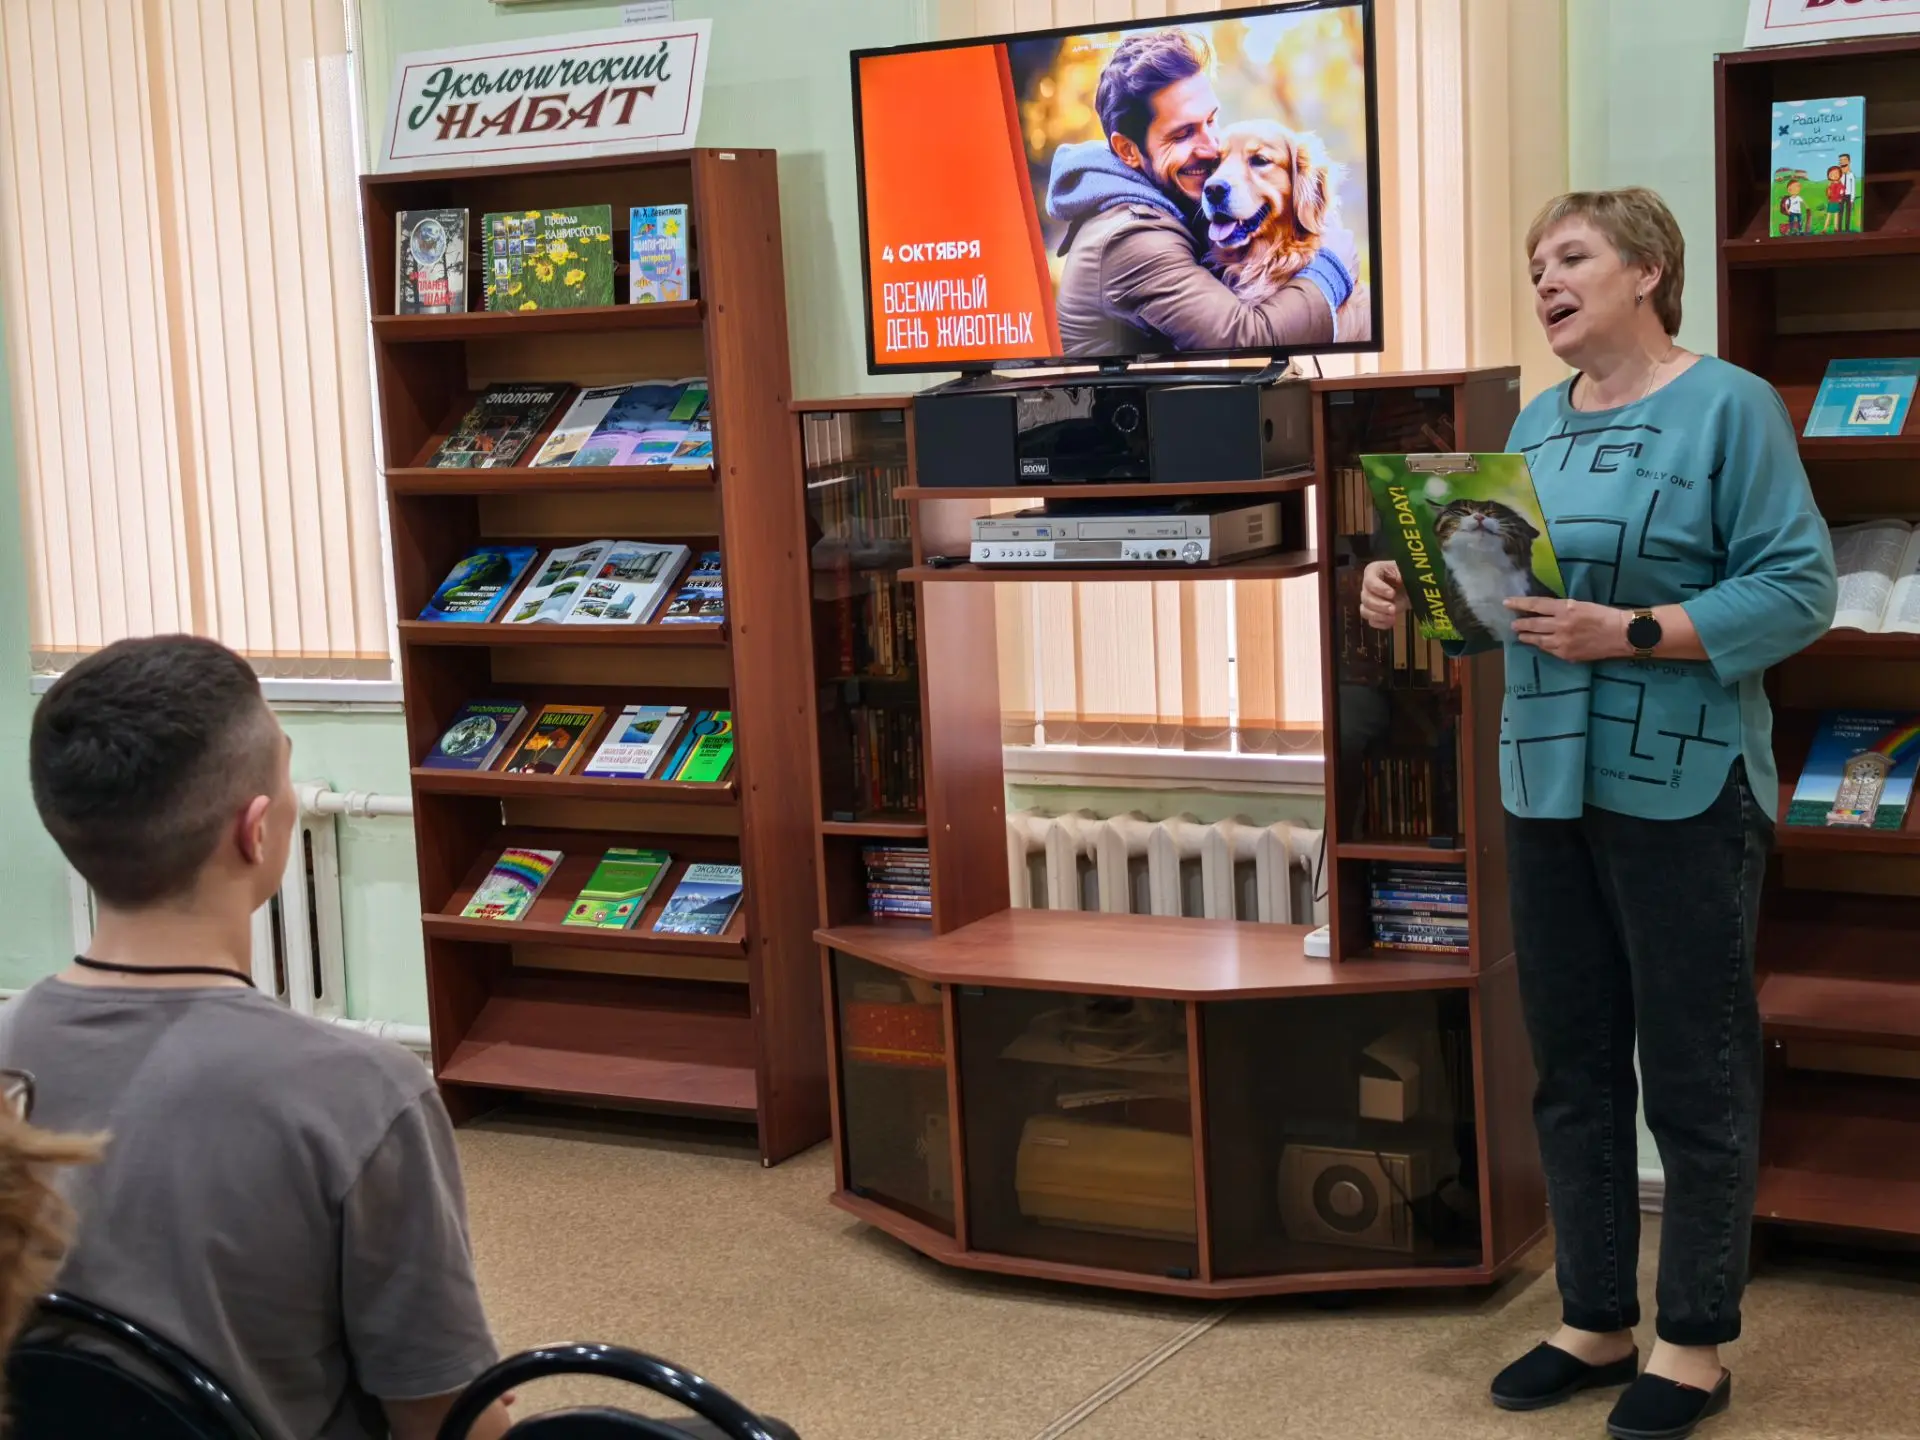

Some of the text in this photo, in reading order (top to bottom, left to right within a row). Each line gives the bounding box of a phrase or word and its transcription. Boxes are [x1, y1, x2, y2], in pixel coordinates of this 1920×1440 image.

[408, 41, 672, 131] Экологический
[435, 84, 657, 141] НАБАТ
[882, 240, 980, 263] 4 ОКТЯБРЯ
[884, 274, 987, 313] ВСЕМИРНЫЙ
[886, 312, 1033, 352] ДЕНЬ ЖИВОТНЫХ
[486, 392, 554, 405] ЭКОЛОГИЯ
[1023, 464, 1046, 473] 800W
[1636, 468, 1695, 490] ONLY ONE
[1388, 486, 1453, 632] HAVE A NICE DAY!
[1663, 666, 1690, 677] ONE
[1600, 768, 1626, 780] ONE
[1670, 768, 1683, 789] ONE
